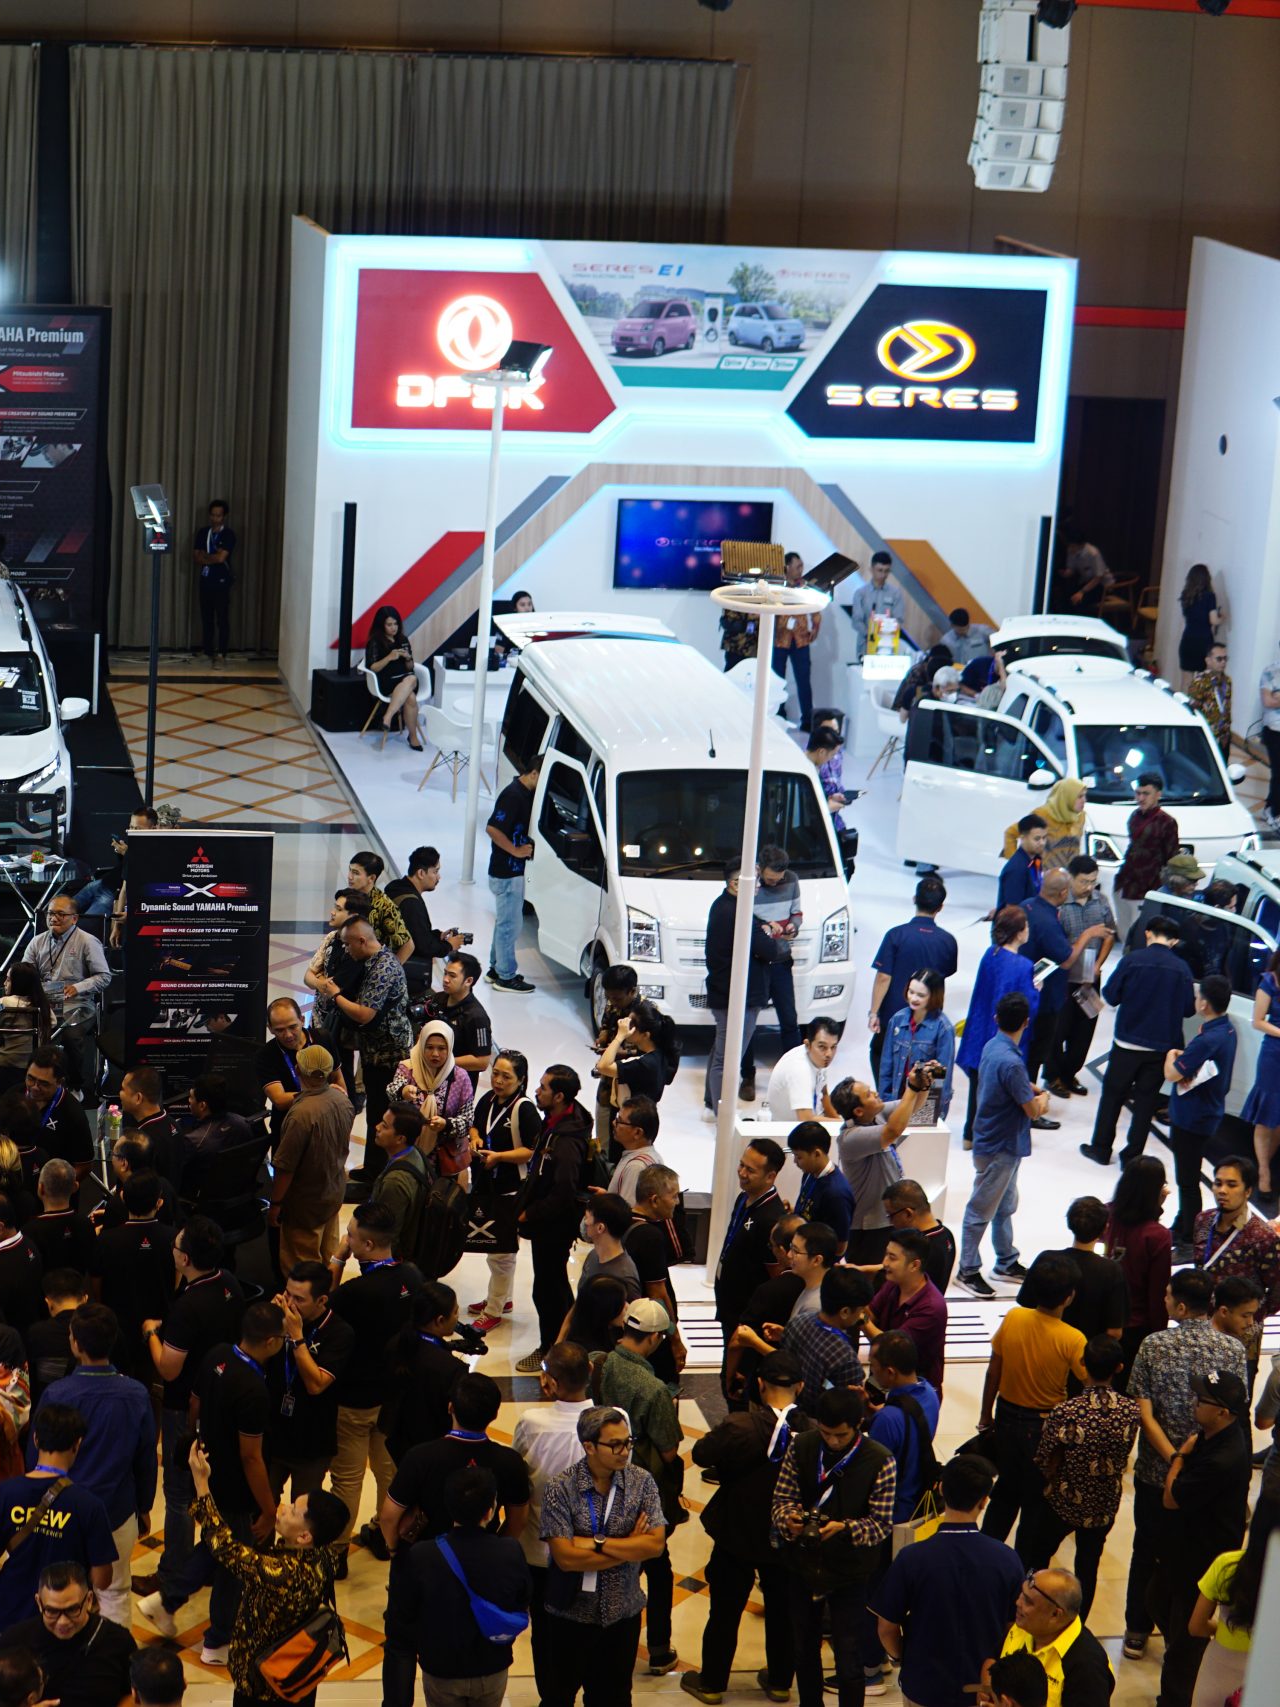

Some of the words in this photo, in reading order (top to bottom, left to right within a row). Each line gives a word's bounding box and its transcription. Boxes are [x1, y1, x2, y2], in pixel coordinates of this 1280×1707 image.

[27, 328, 84, 343] Premium
[826, 384, 1019, 411] SERES
[141, 902, 171, 913] Dynamic
[172, 903, 195, 911] Sound
[196, 903, 225, 911] YAMAHA
[227, 903, 258, 911] Premium
